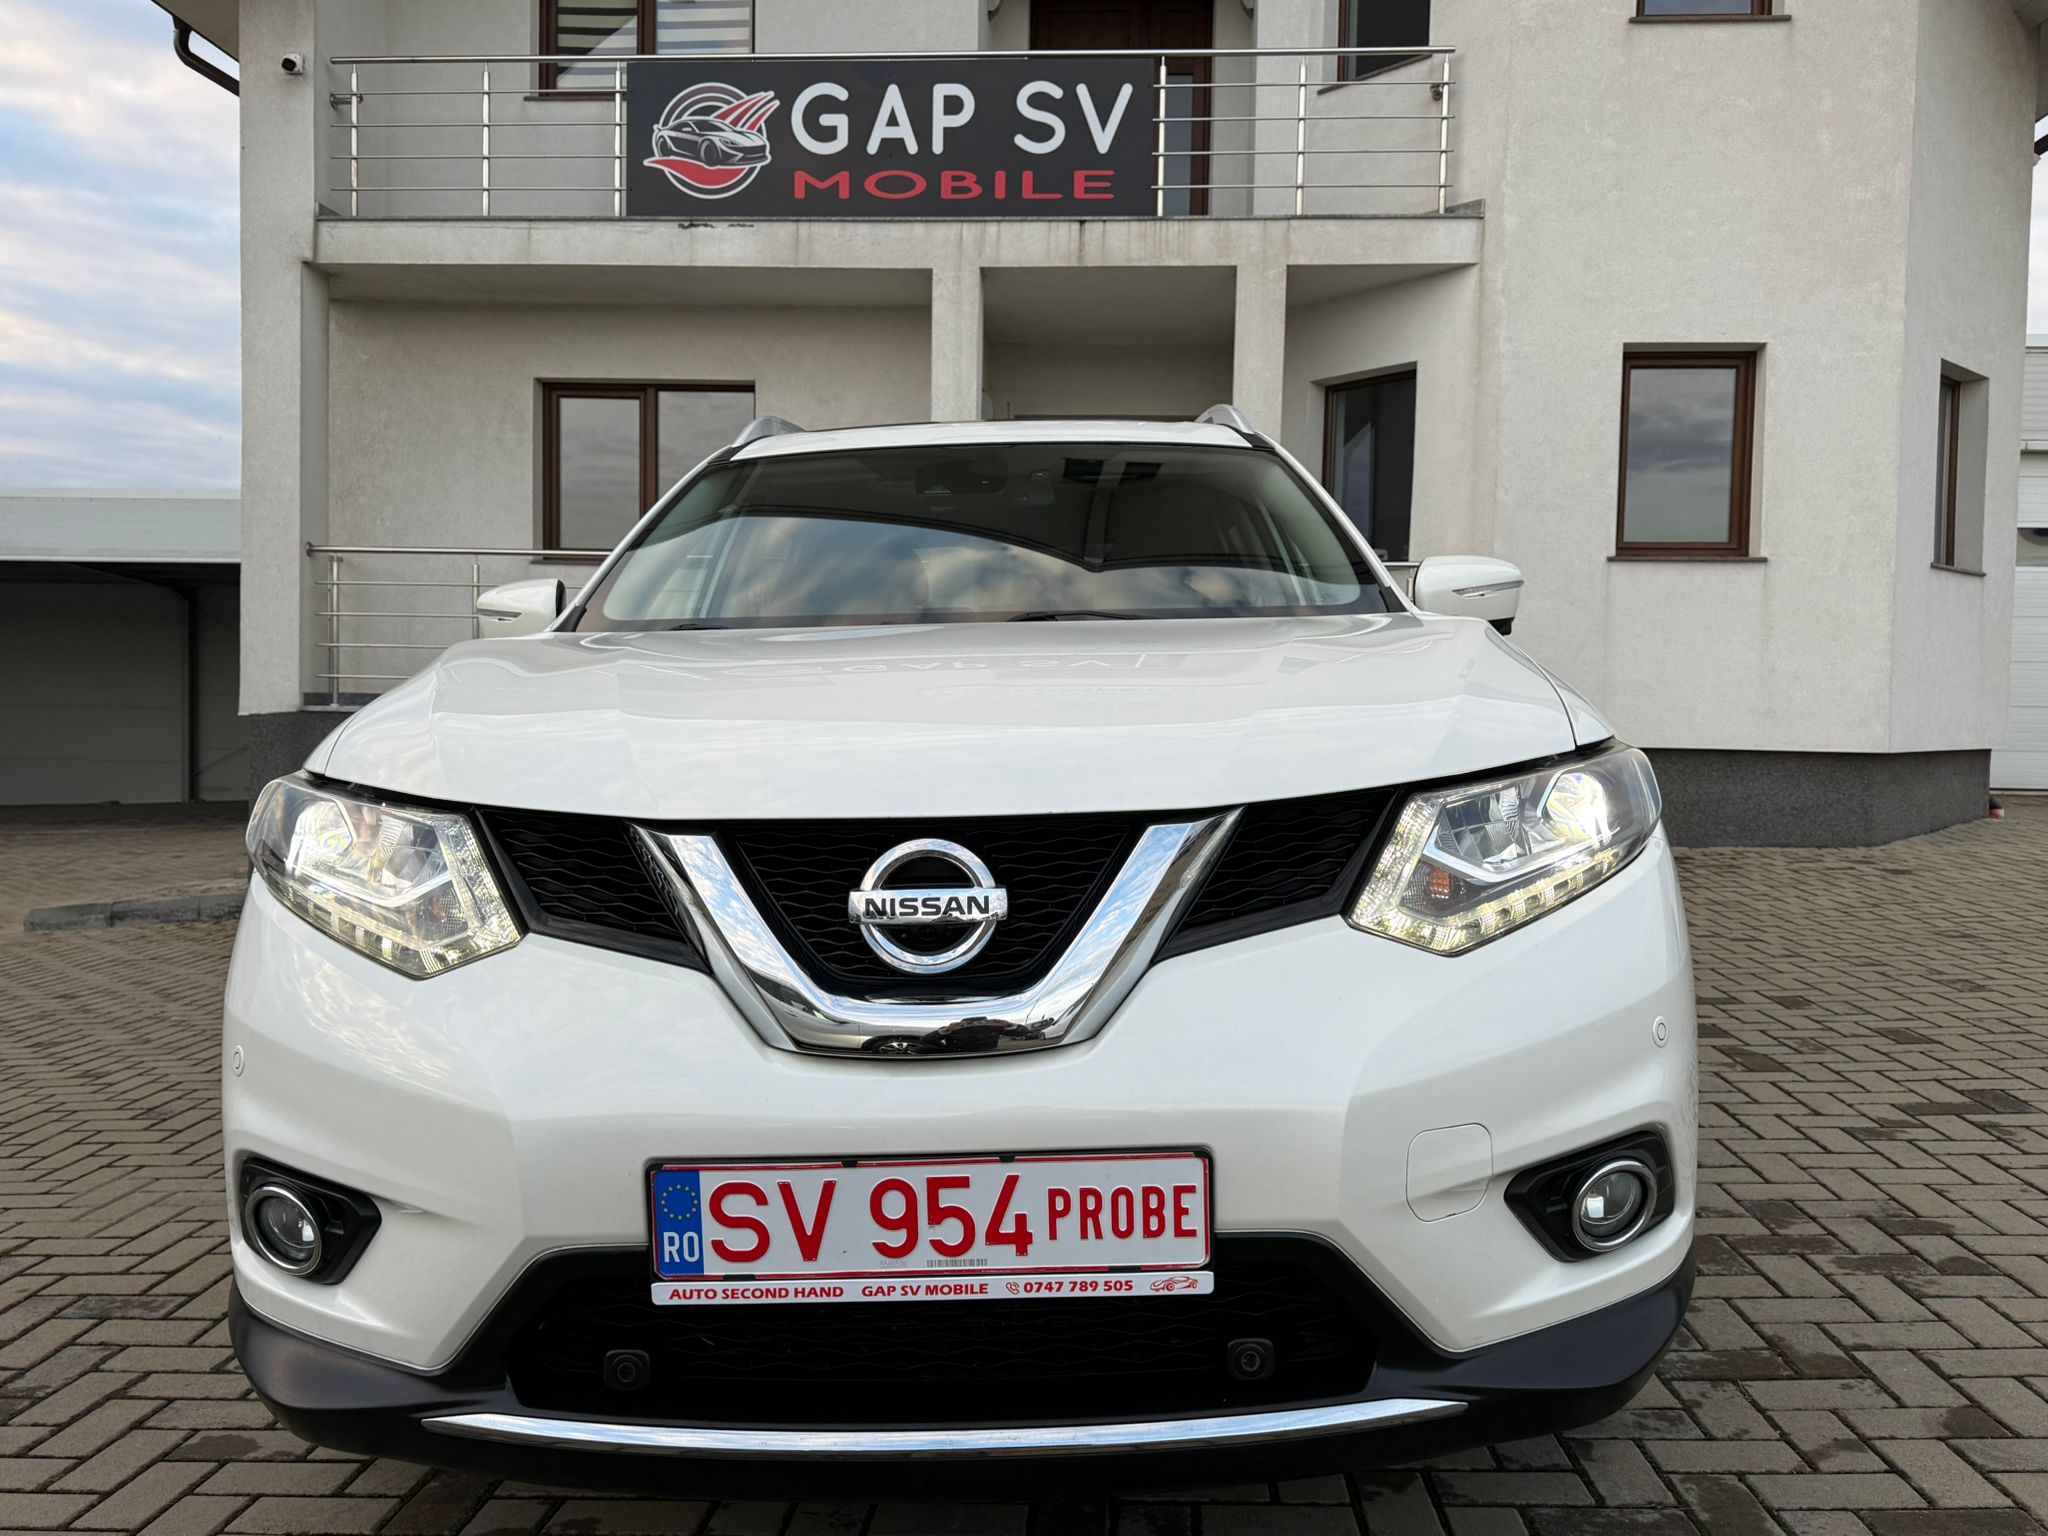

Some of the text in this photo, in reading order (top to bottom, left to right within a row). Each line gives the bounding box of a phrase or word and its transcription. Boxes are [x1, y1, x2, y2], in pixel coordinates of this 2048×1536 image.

[790, 79, 1134, 156] GAP SV
[793, 169, 1116, 201] MOBILE
[864, 895, 990, 917] NISSAN
[708, 1173, 1198, 1264] SV 954 PROBE
[663, 1231, 700, 1263] RO
[668, 1279, 1134, 1301] AUTO SECOND HAND GAP SV MOBILE 0747 789 505
